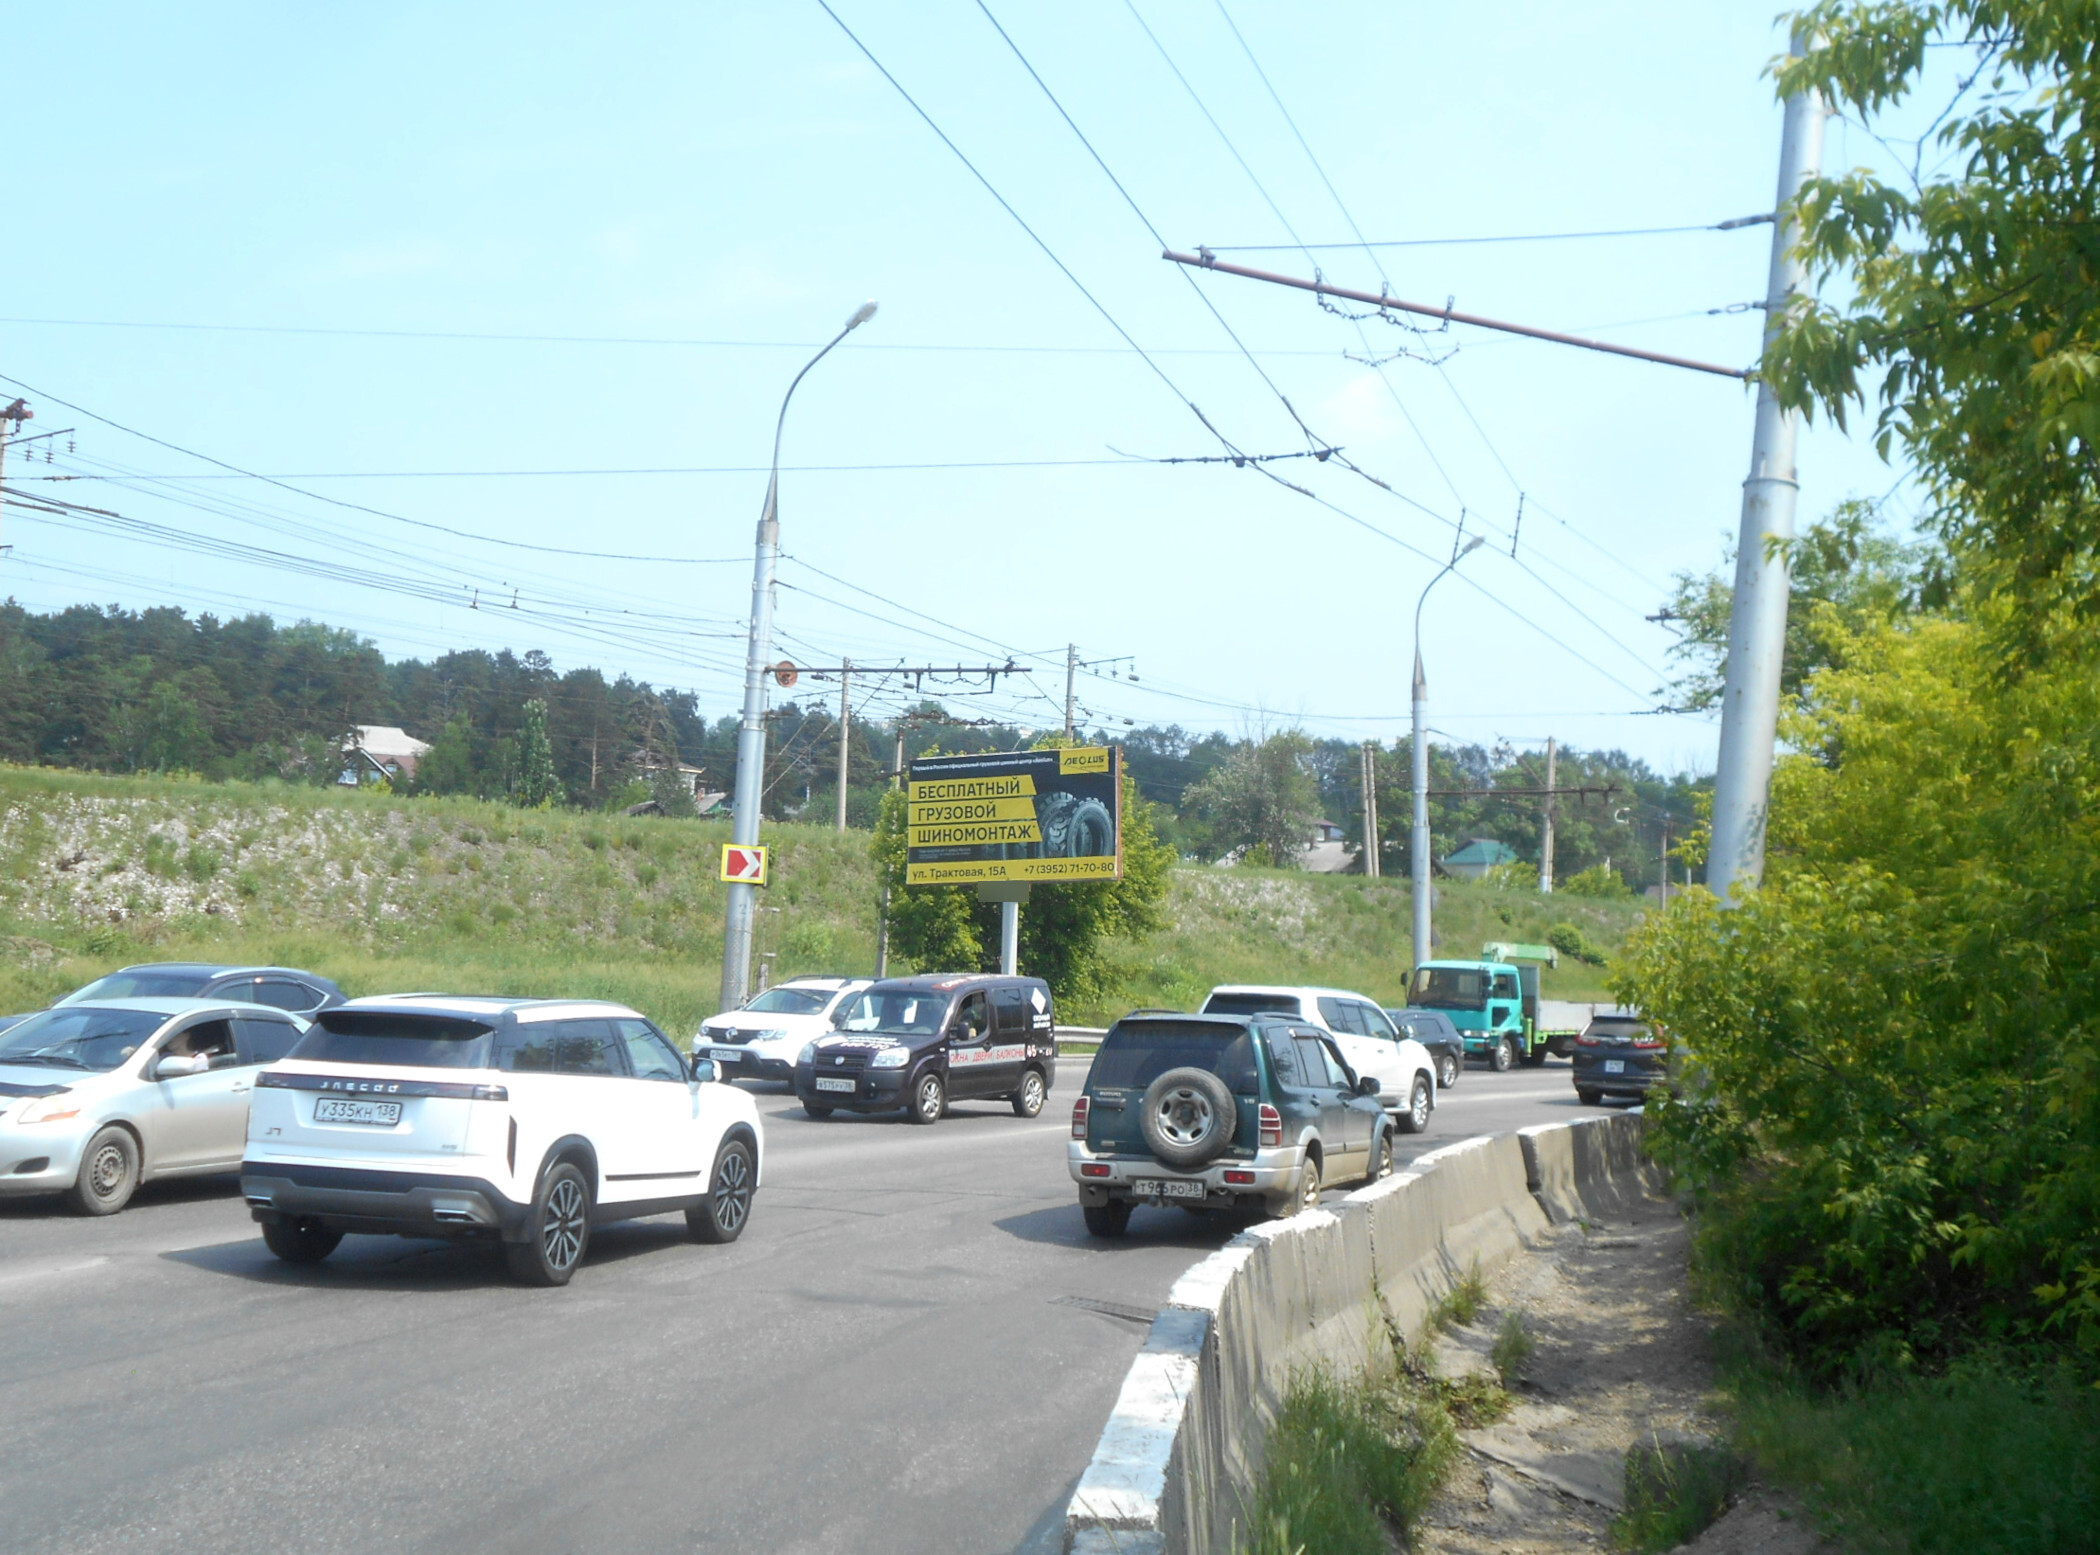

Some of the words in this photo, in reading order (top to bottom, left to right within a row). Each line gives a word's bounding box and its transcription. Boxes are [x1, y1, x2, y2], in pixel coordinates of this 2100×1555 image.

[1064, 755, 1105, 766] AEOLUS
[918, 777, 1020, 799] БЕСПЛАТНЫЙ
[918, 801, 996, 821] ГРУЗОВОЙ
[912, 870, 927, 880] ул.
[930, 866, 986, 879] Трактовая,
[988, 866, 1006, 876] 15А
[1024, 865, 1034, 875] +7
[1036, 864, 1068, 875] (3952)
[1070, 862, 1115, 873] 71-70-80
[950, 1053, 969, 1063] ОКНА
[996, 1048, 1025, 1060] БАЛКОНЫ
[321, 1102, 372, 1118] У335КН
[376, 1104, 397, 1117] 138
[1187, 1182, 1199, 1193] 38
